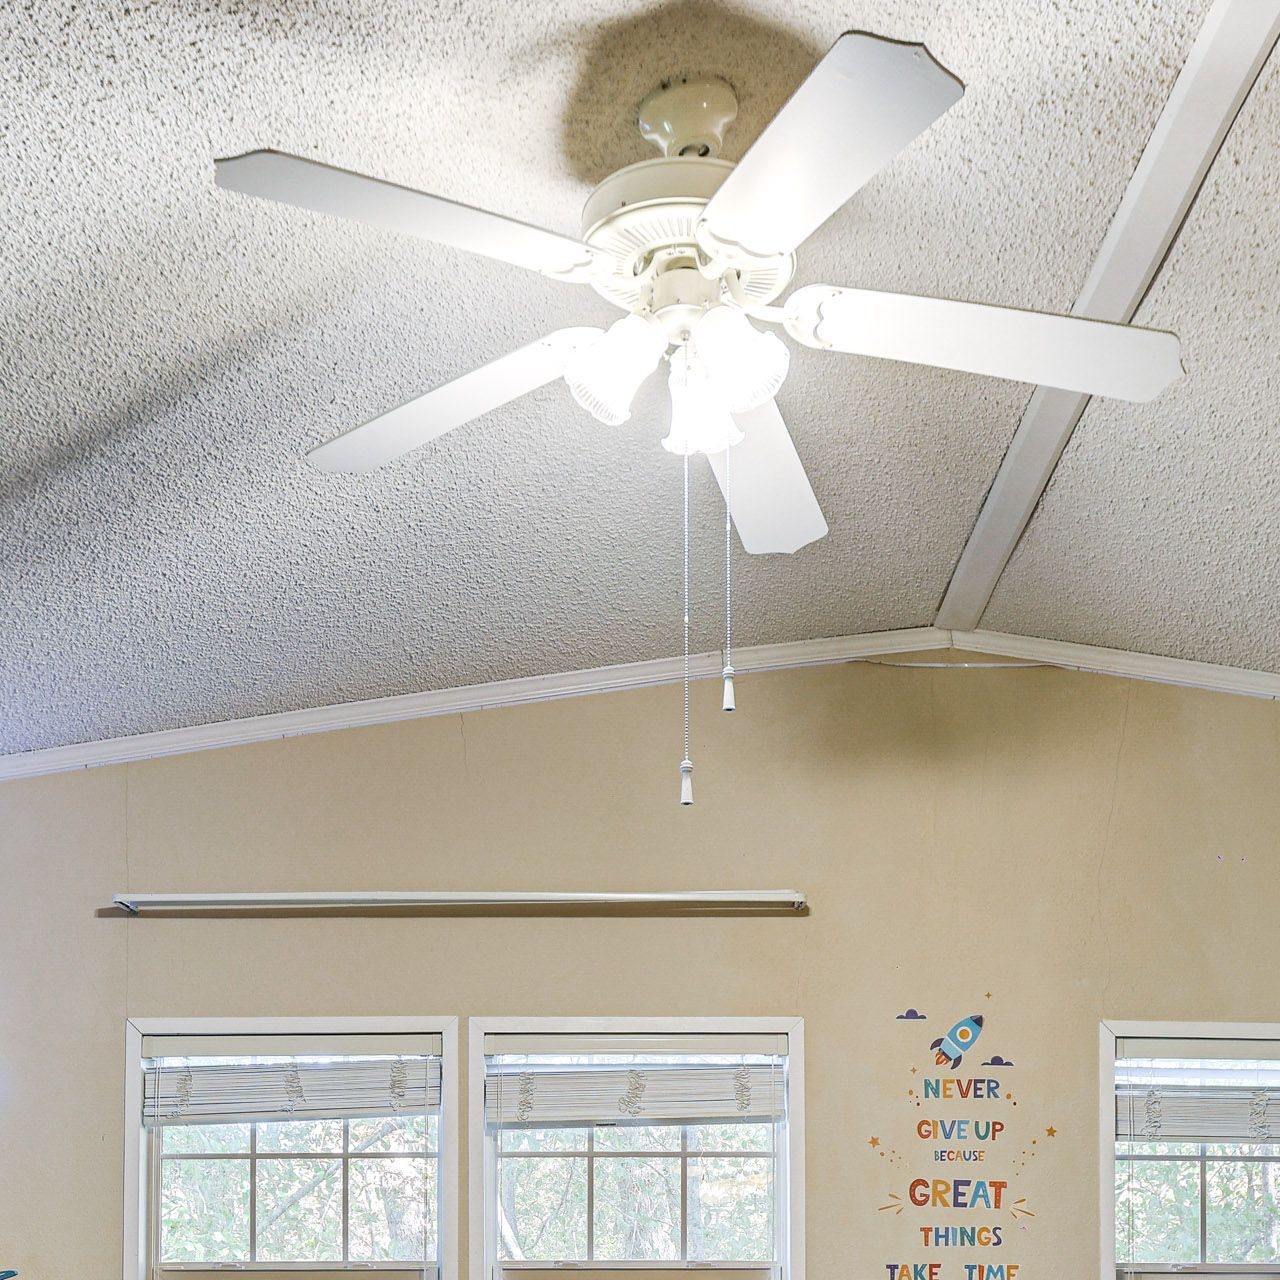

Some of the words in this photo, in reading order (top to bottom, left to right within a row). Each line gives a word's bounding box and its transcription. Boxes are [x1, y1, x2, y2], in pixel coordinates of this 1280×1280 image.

[924, 1078, 1000, 1099] NEVER
[916, 1119, 971, 1140] GIVE
[975, 1119, 1004, 1141] UP
[934, 1150, 985, 1162] BECAUSE
[909, 1179, 1008, 1209] GREAT
[920, 1226, 1002, 1247] THINGS
